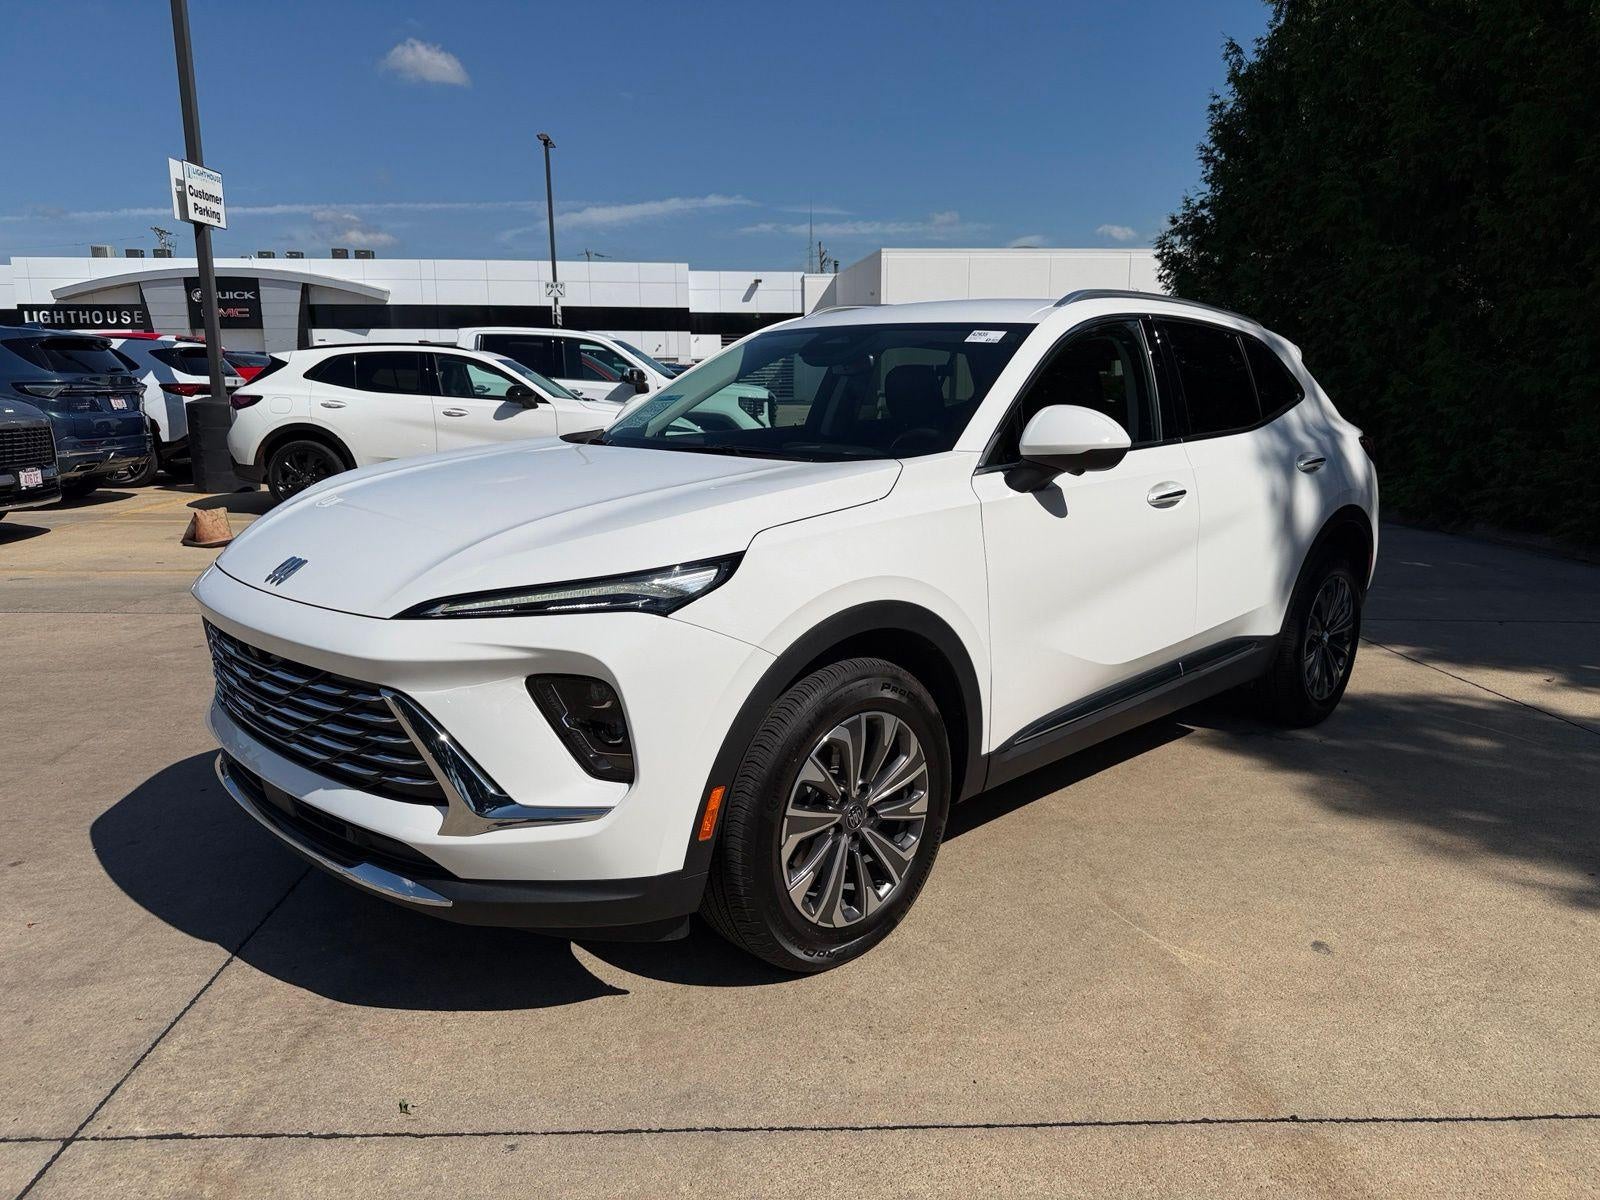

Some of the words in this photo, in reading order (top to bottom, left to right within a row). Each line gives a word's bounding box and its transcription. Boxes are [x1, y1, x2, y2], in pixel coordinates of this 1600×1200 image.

[192, 168, 222, 184] LIGHTHOUSE
[188, 185, 223, 206] Customer
[193, 203, 221, 223] Parking
[216, 291, 256, 300] UICK
[23, 310, 144, 324] LIGHTHOUSE
